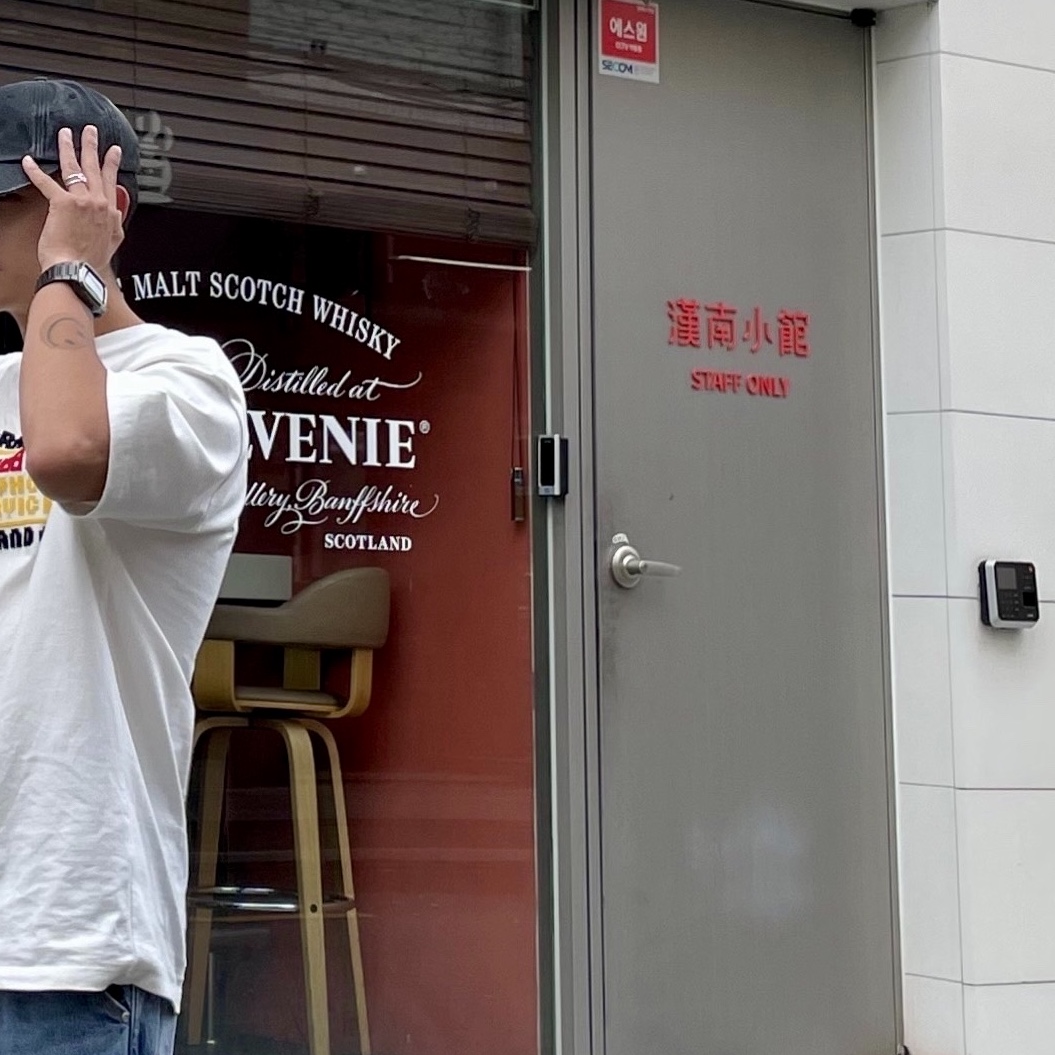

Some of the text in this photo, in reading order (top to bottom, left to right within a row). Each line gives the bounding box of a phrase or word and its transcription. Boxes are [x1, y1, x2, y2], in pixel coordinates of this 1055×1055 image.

[609, 16, 647, 43] 에스원
[601, 60, 634, 75] SECOM
[132, 270, 201, 301] MALT
[209, 271, 304, 315] SCOTCH
[312, 294, 401, 360] WHISKY
[667, 298, 810, 358] 漢南小館
[221, 338, 422, 401] Distilled at
[691, 370, 790, 399] STAFF ONLY
[295, 478, 440, 525] Banffshire
[324, 532, 412, 552] SCOTLAND
